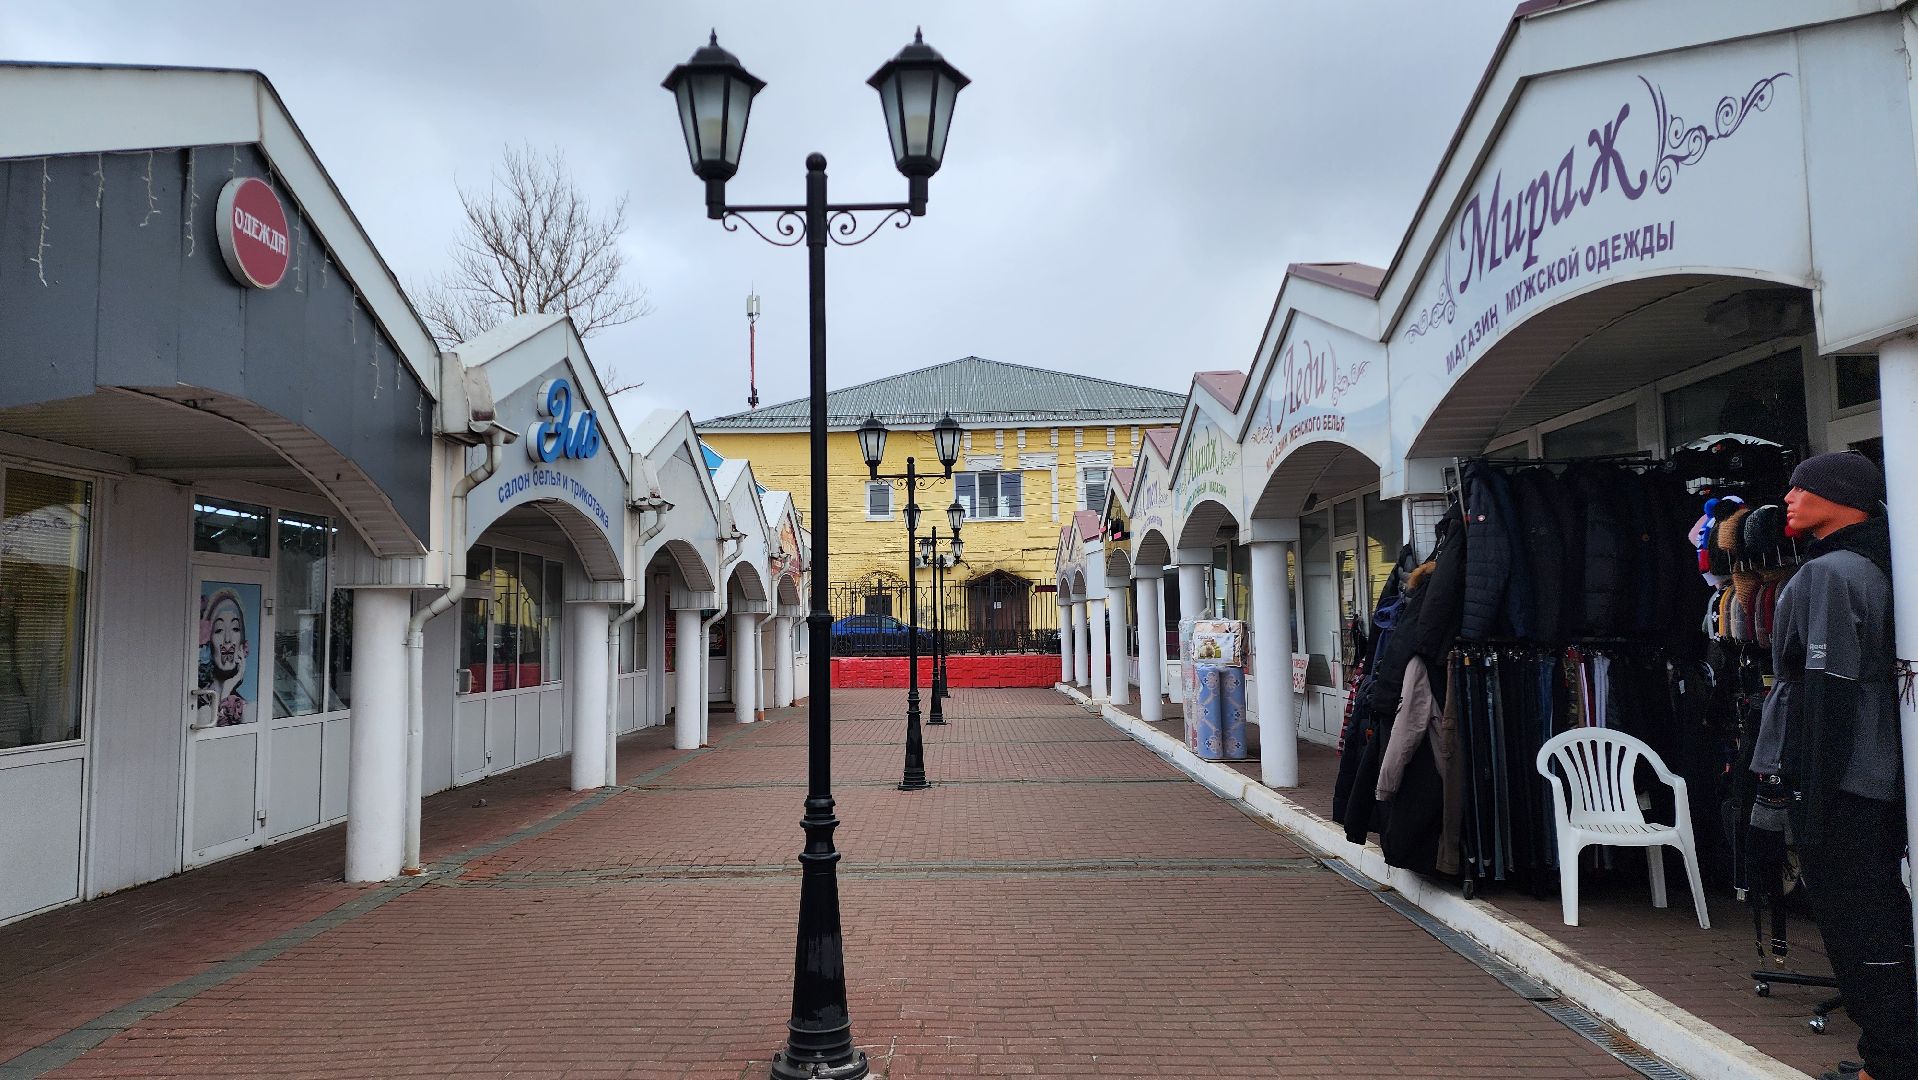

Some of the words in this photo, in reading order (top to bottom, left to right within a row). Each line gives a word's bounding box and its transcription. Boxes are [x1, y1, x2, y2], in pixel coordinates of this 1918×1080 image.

[234, 206, 287, 255] ОДЕЖДА
[1459, 102, 1648, 294] Мираж
[1446, 305, 1499, 374] МАГАЗИН
[1505, 246, 1582, 315] МУЖСКОЙ
[1585, 220, 1676, 273] ОДЕЖДЫ
[529, 379, 600, 464] Эль
[1276, 340, 1327, 432] Леди
[1266, 433, 1289, 473] МАГАЗИН
[1289, 415, 1321, 444] ЖЕНСКОГО
[1322, 414, 1345, 432] БЕЛЬЯ
[498, 473, 530, 503] салон
[532, 465, 561, 486] белья
[562, 475, 568, 490] и
[570, 477, 609, 528] трикотажа
